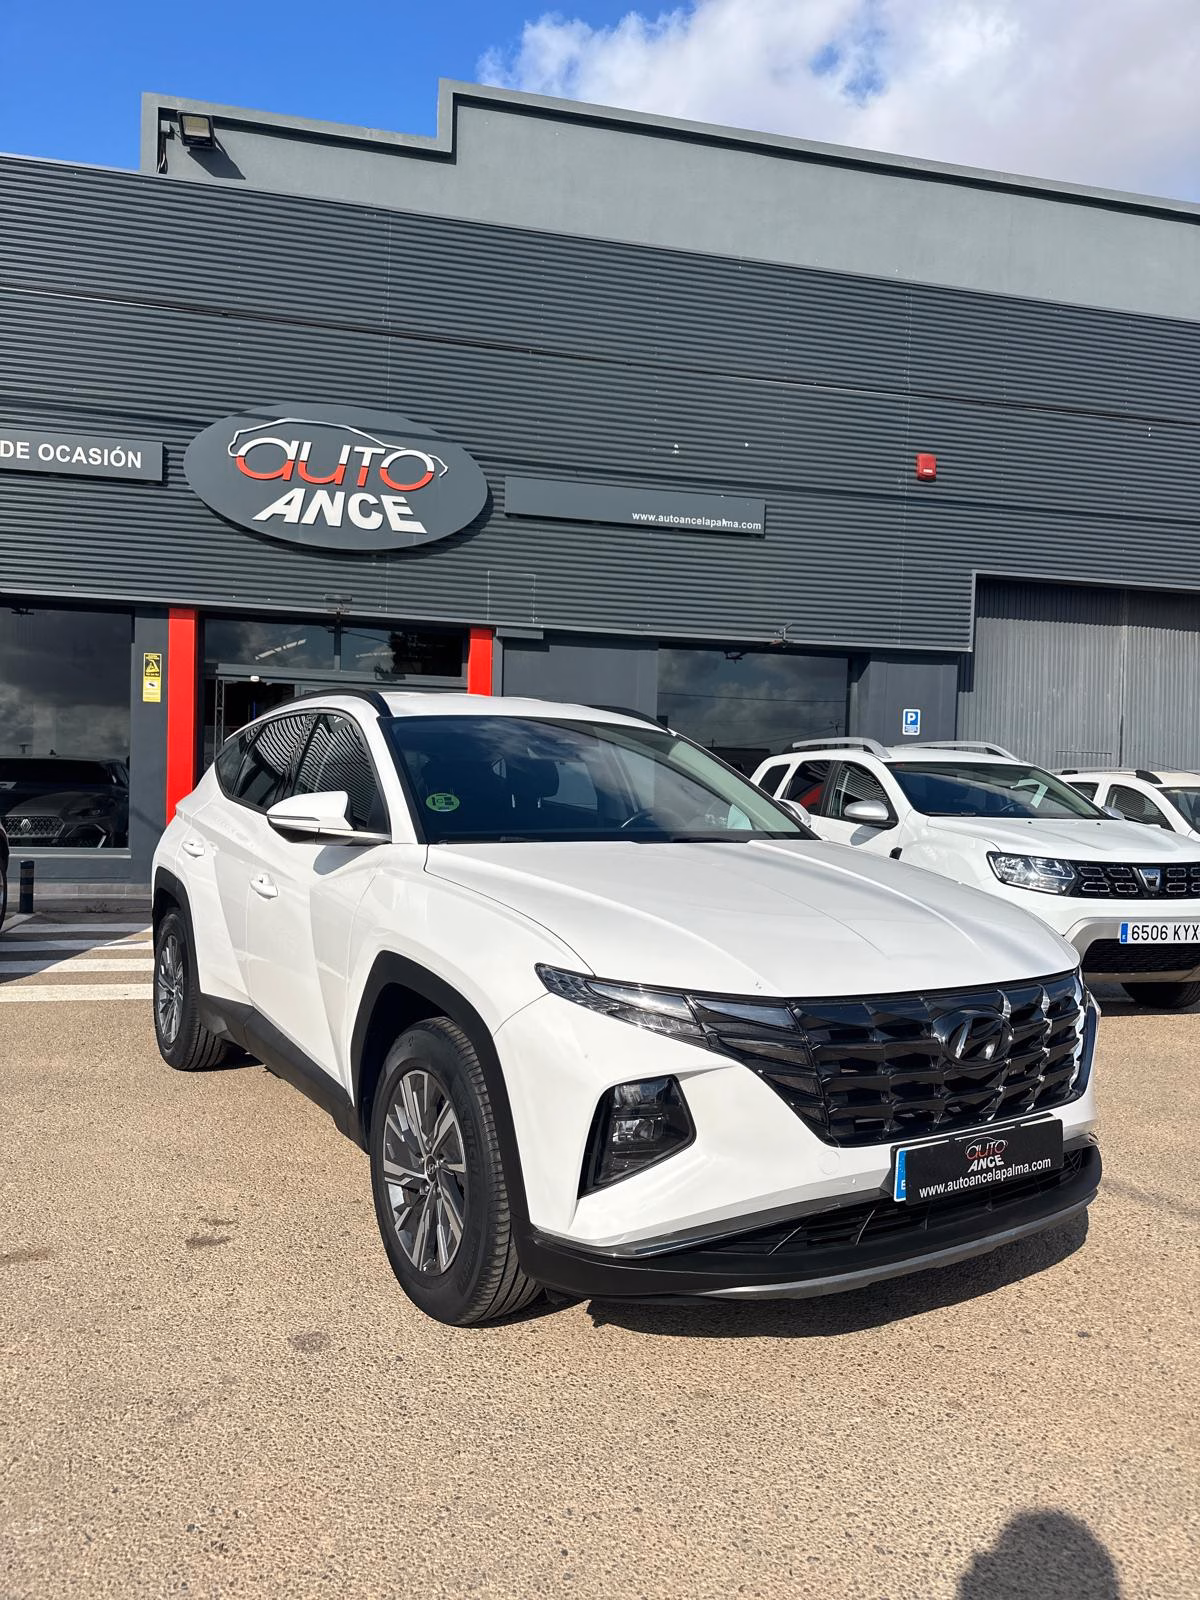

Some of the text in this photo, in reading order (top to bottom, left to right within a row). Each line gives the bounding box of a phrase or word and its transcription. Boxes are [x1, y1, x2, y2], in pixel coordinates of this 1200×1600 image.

[0, 440, 142, 469] DE OCASIÓN
[252, 487, 428, 534] ANCE
[632, 512, 761, 530] www.autoancelapalma.com
[907, 713, 916, 724] P
[1131, 925, 1200, 941] 6506 KYX
[967, 1154, 1005, 1173] ANCE
[919, 1157, 1051, 1199] www.autoancelapalma.com
